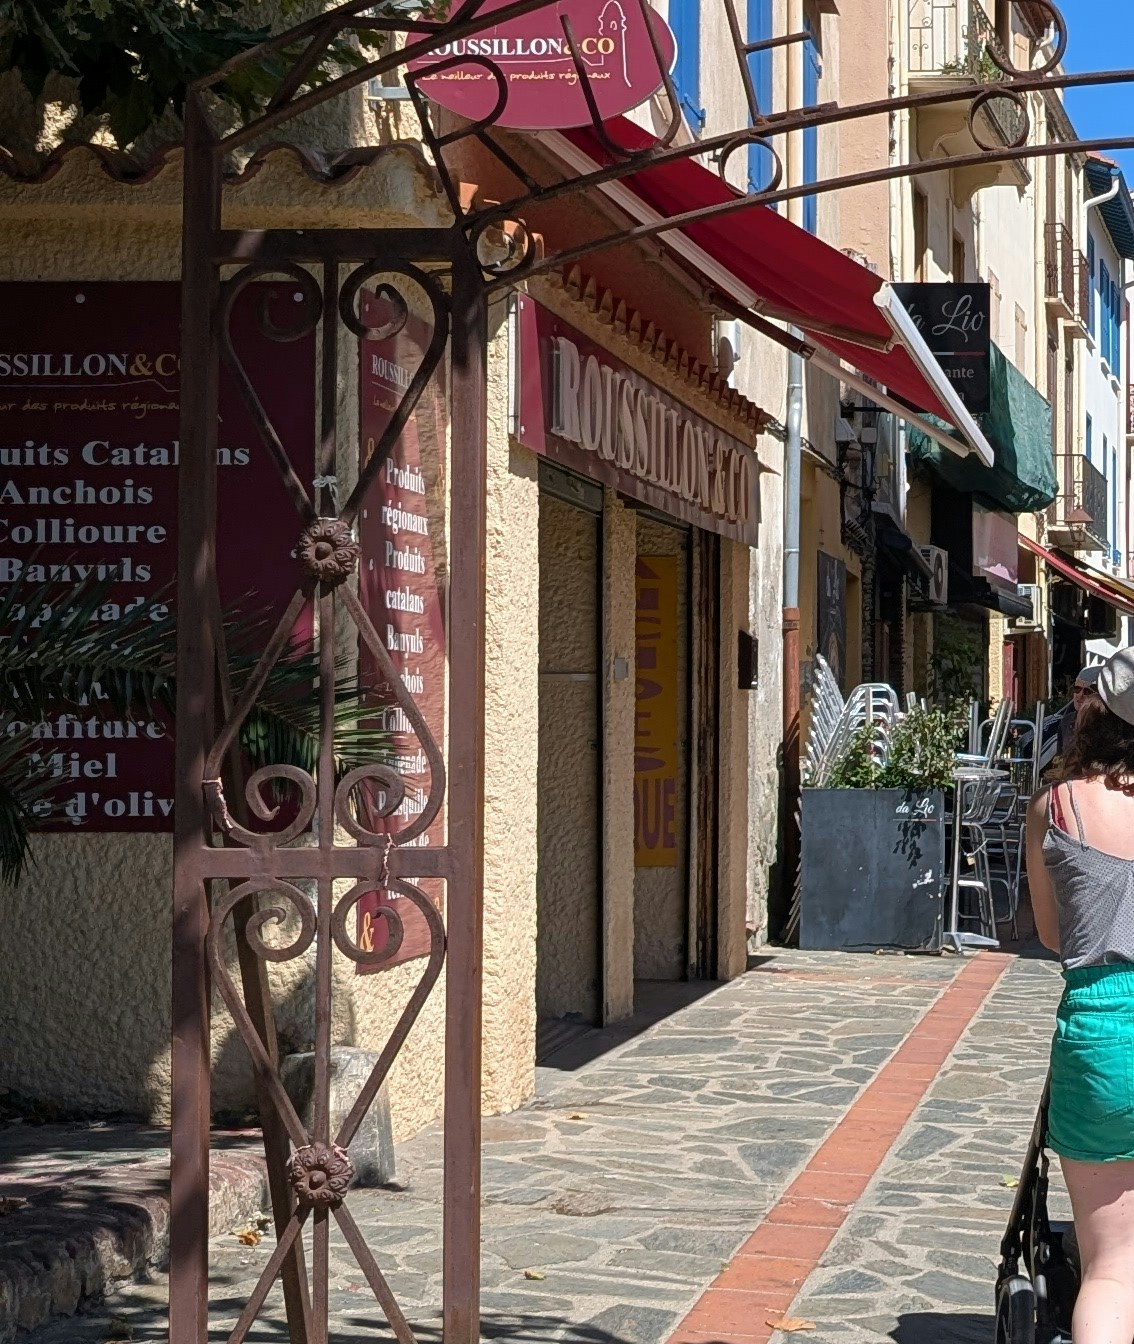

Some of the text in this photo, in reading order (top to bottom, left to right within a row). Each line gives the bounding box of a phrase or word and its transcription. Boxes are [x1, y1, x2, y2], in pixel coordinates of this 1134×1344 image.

[510, 70, 555, 82] produits
[931, 294, 986, 343] Lio
[0, 353, 180, 376] SSILLON&C
[54, 398, 116, 413] produits
[551, 336, 751, 523] ROUSSILLON&CO
[82, 440, 250, 466] Catalns
[386, 457, 426, 495] Produits
[0, 479, 153, 505] Anchois
[381, 500, 428, 535] régionaux
[386, 541, 425, 574] Produits
[0, 557, 152, 588] Banyuls
[386, 586, 424, 614] catalans
[387, 624, 424, 659] Banyuls
[0, 713, 167, 739] onfiture
[26, 752, 118, 778] Miel
[65, 790, 175, 819] d'oliv
[896, 801, 909, 814] da
